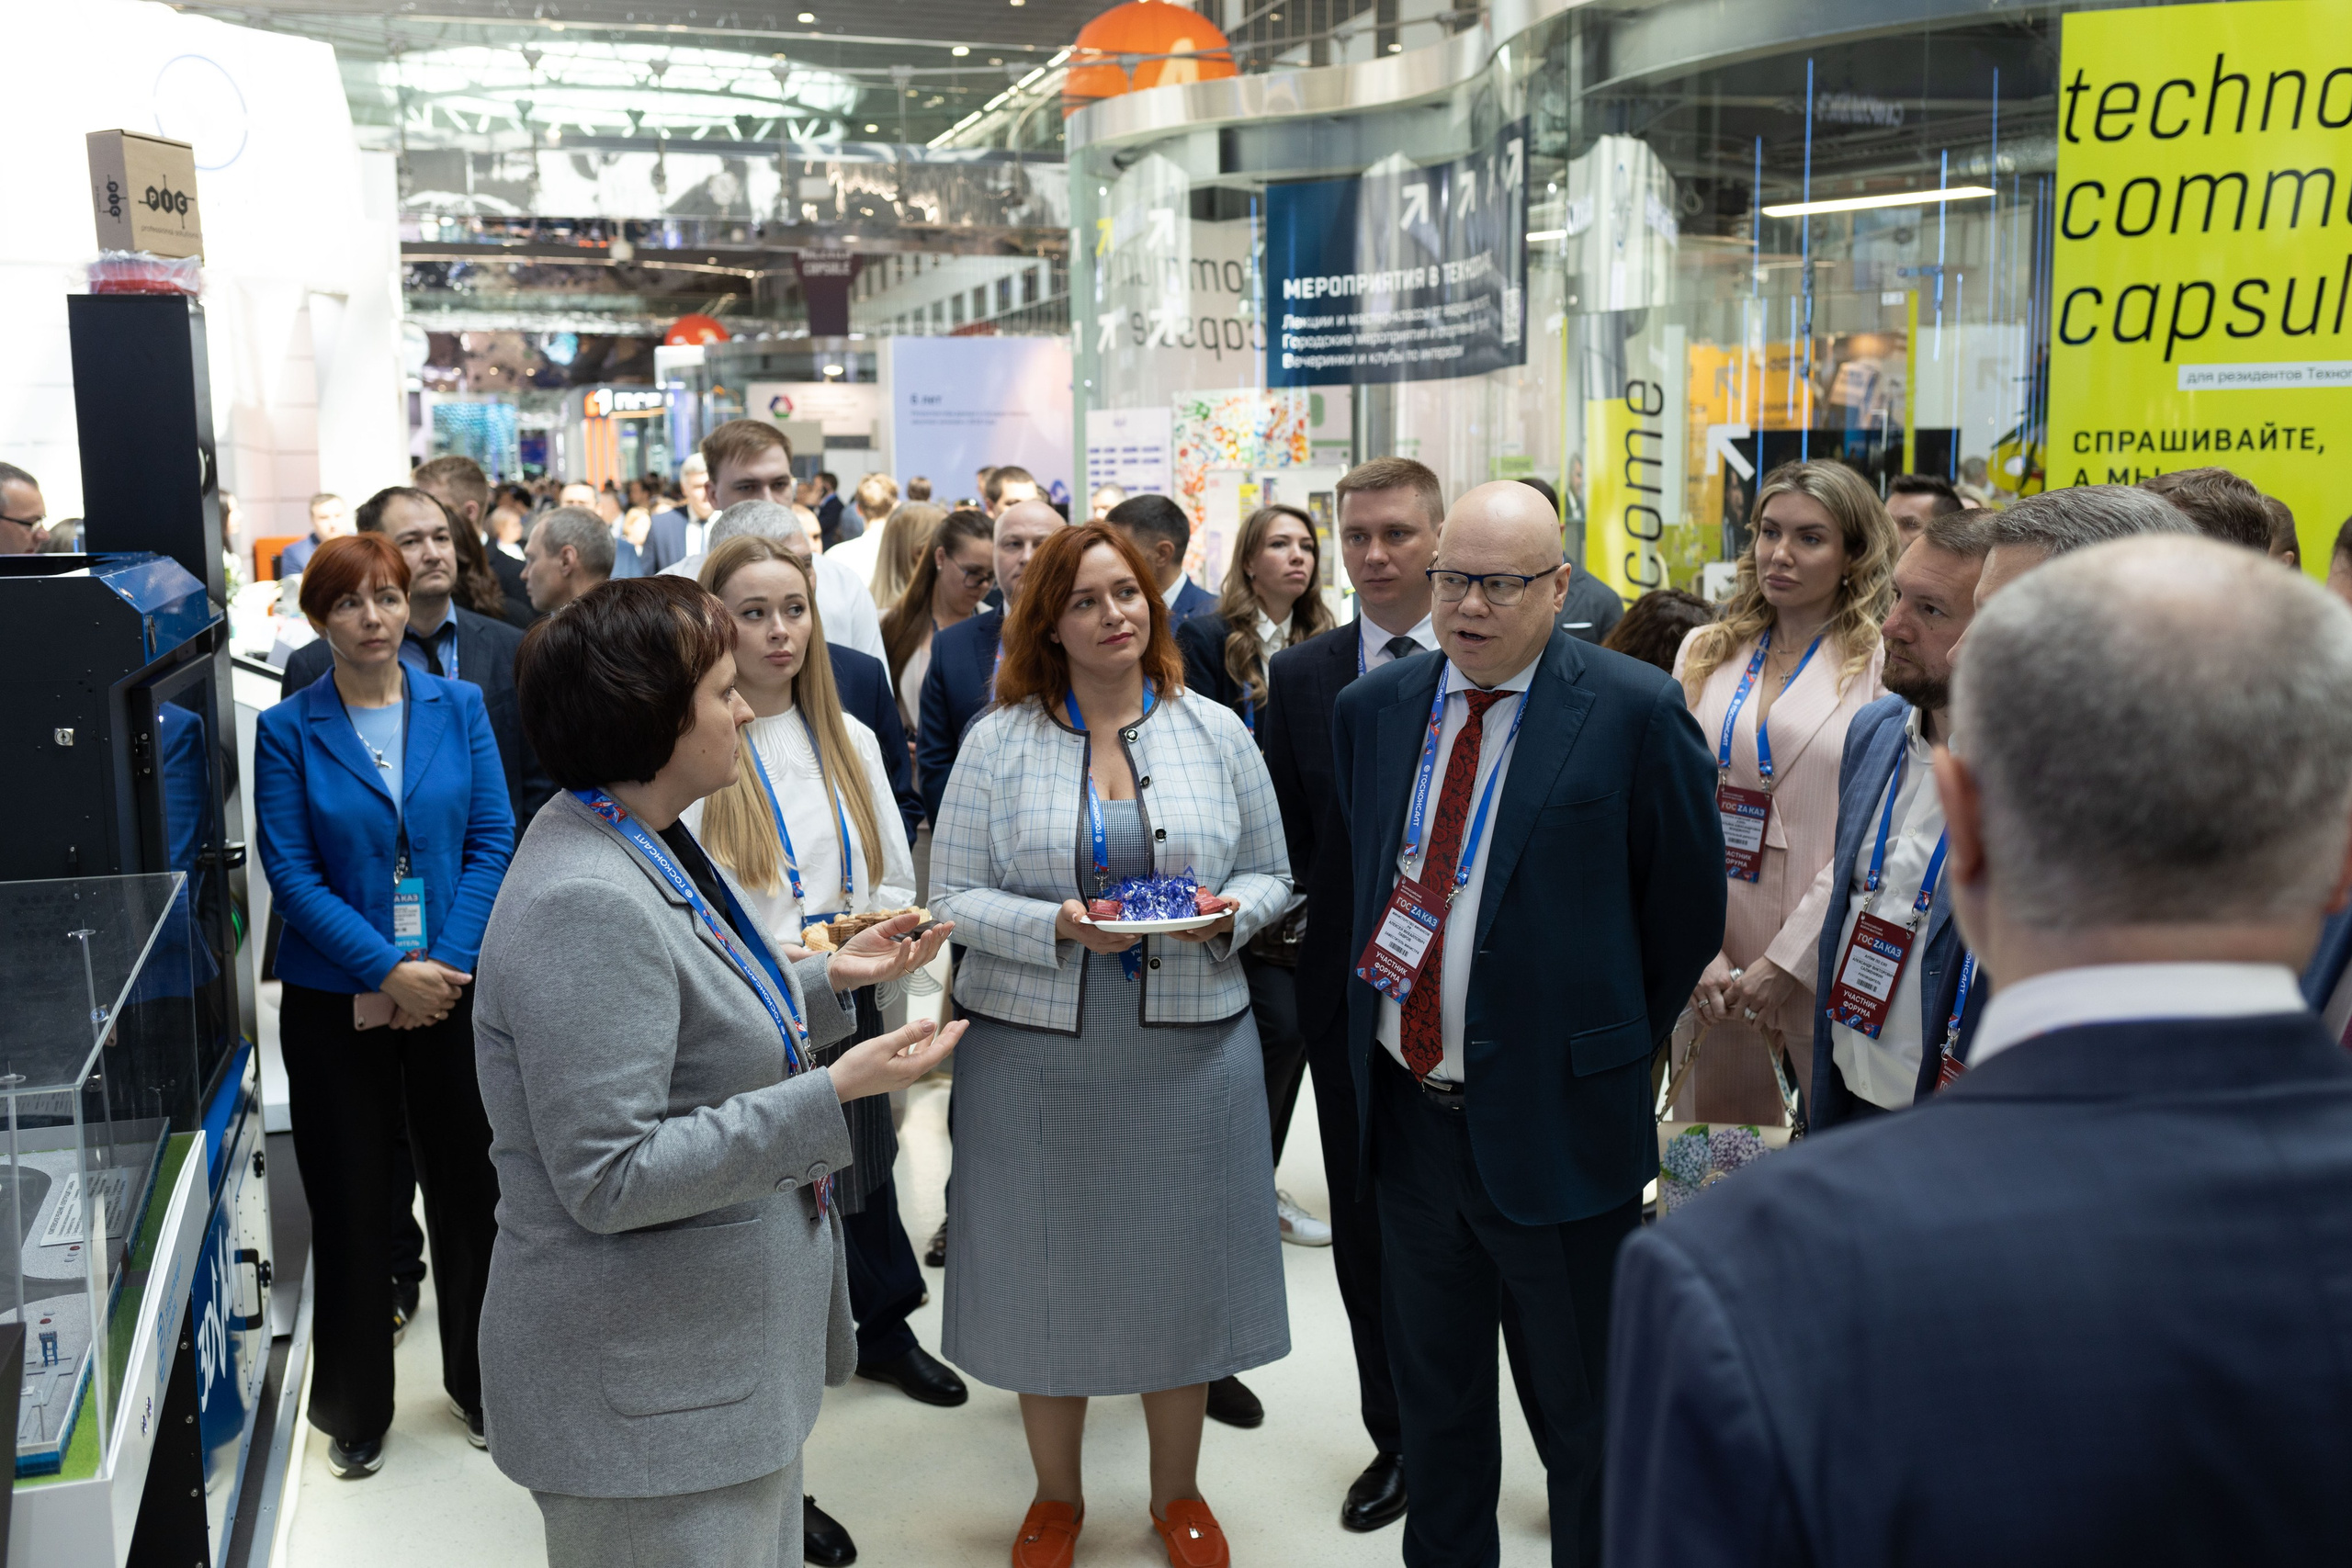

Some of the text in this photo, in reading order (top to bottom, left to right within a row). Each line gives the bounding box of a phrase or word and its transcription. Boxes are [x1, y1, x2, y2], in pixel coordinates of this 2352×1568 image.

[2061, 167, 2352, 241] comm
[1283, 267, 1425, 300] МЕРОПРИЯТИЯ
[2187, 371, 2213, 385] для
[2218, 368, 2301, 384] резидентов
[2074, 422, 2325, 455] СПРАШИВАЙТЕ,
[1413, 774, 1428, 827] ГОСКОНСАЛТ
[634, 833, 684, 889] ГОСКОНСАЛТ
[1374, 962, 1400, 983] ФОРУМА
[1376, 951, 1408, 976] УЧАСТНИК
[744, 964, 781, 1024] ГОСКОНСАЛТ
[1843, 990, 1877, 1010] УЧАСТНИК
[1843, 1000, 1871, 1018] ФОРУМА
